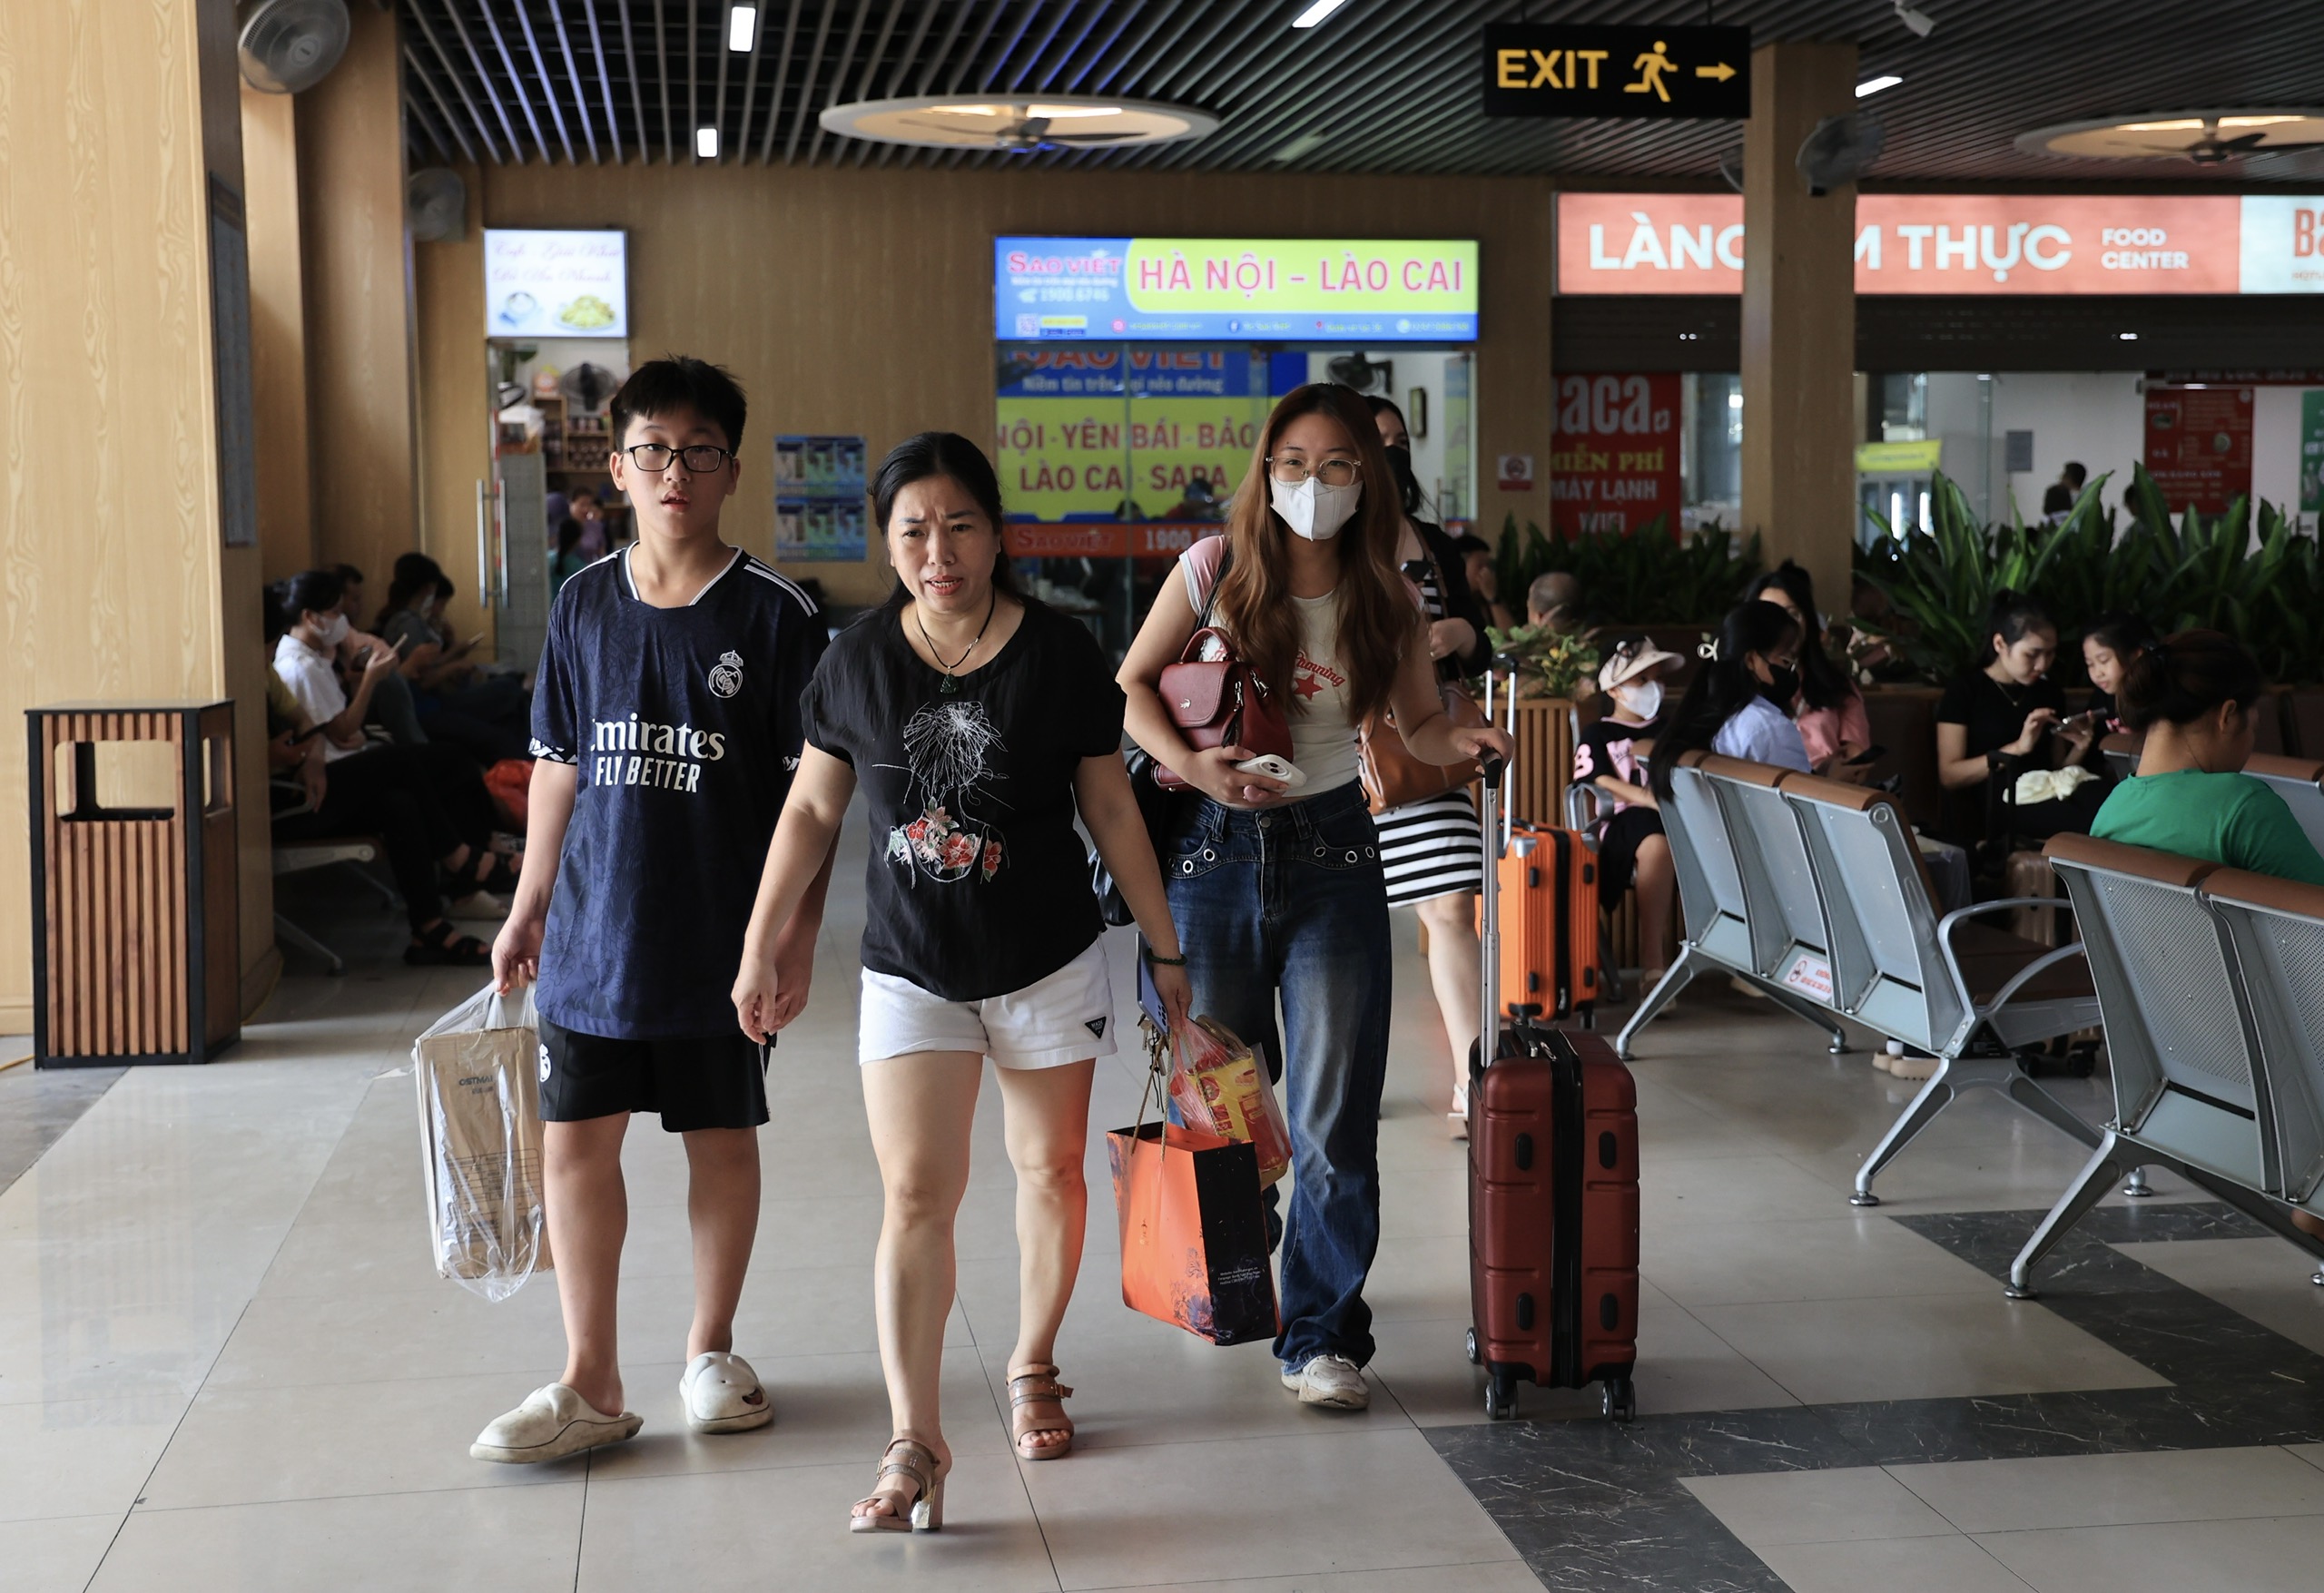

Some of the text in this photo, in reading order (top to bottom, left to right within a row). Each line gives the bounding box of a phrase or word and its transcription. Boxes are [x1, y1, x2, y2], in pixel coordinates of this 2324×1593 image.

[1498, 49, 1609, 89] EXIT
[1896, 221, 2073, 283] THỰC
[2101, 228, 2167, 247] FOOD
[1009, 252, 1063, 273] SAO
[1139, 251, 1191, 290] HÀ
[1206, 253, 1275, 298] NỘI
[1322, 252, 1389, 290] LÀO
[1403, 260, 1461, 290] CAI
[2101, 251, 2190, 270] CENTER
[1551, 375, 1650, 435] aca
[1061, 417, 1119, 449] YÊN
[1130, 416, 1179, 449] BÁI
[1019, 459, 1076, 492] LÀO
[1084, 465, 1126, 492] CA
[590, 713, 726, 762] mirates
[595, 755, 702, 793] FLY BETTER
